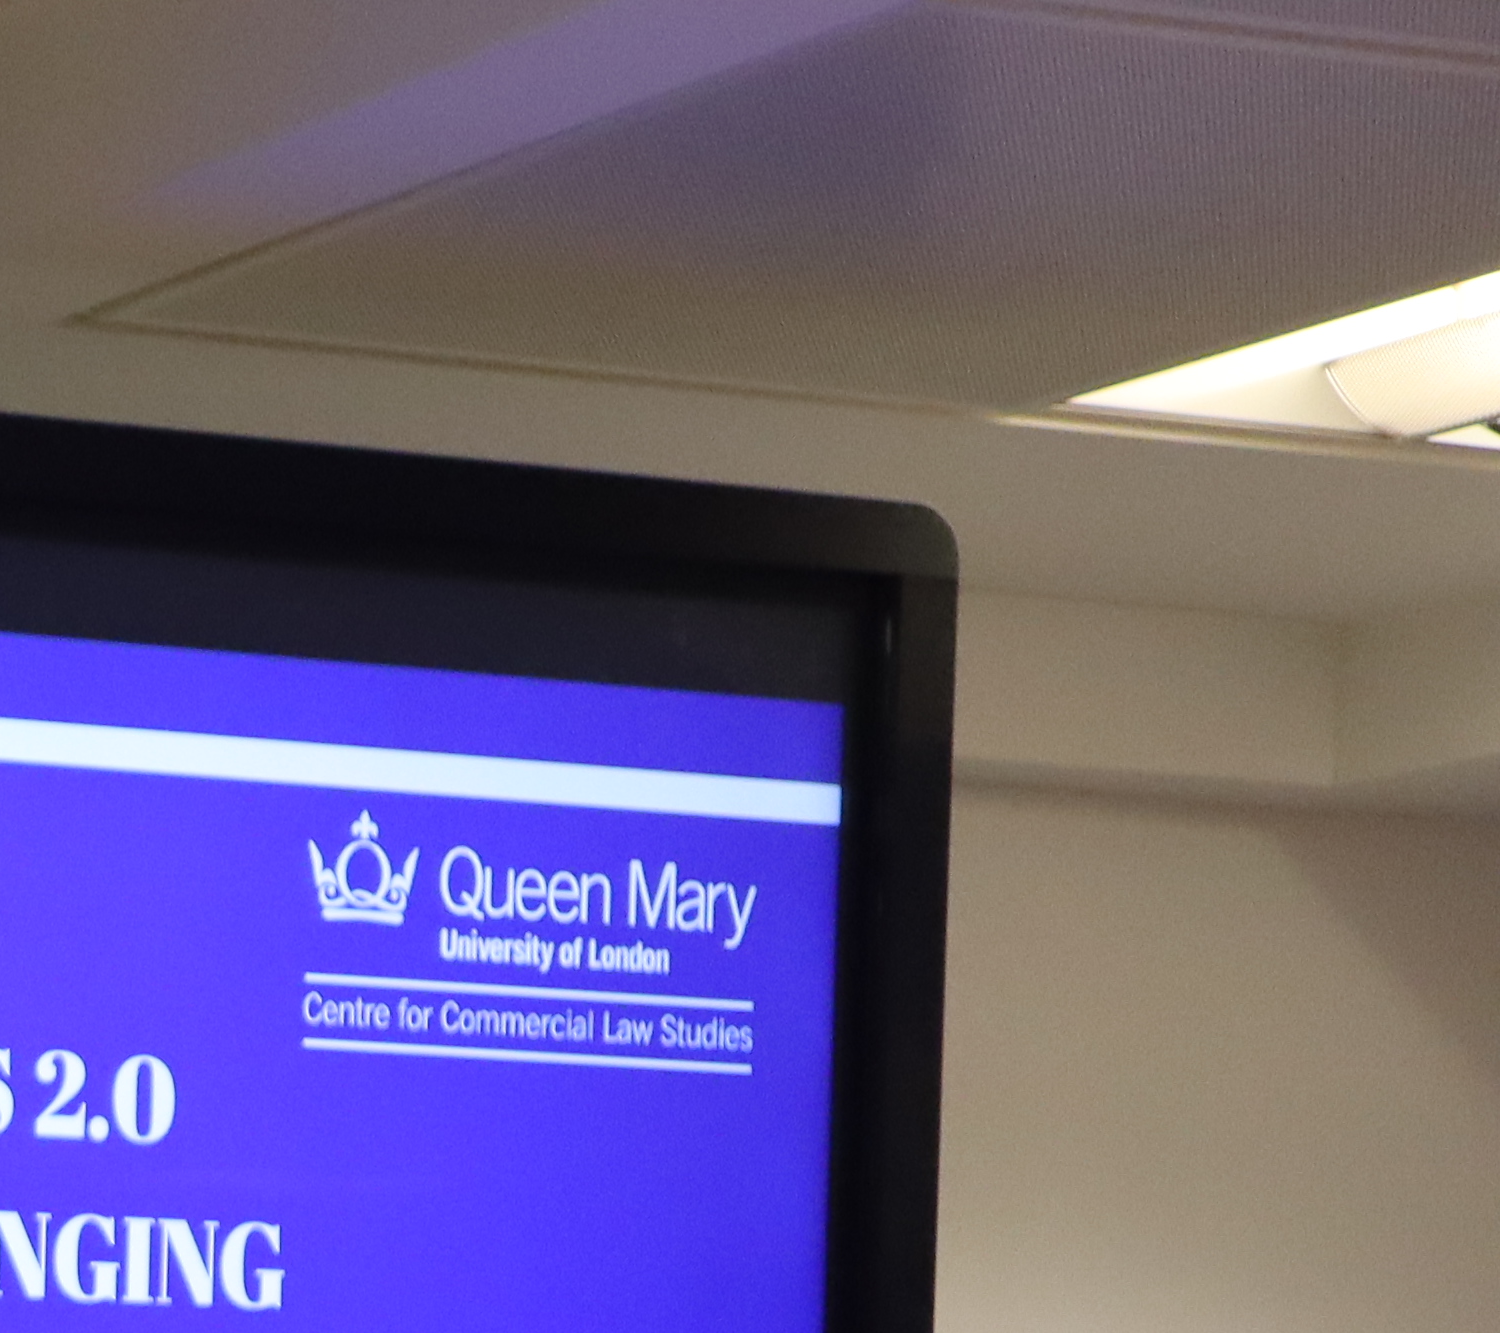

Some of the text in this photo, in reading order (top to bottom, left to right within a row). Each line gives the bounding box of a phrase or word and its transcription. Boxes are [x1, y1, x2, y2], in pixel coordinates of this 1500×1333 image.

[438, 844, 758, 951] Queen Mary
[438, 926, 671, 975] University of London
[301, 989, 754, 1053] Centre for Commercial Law Studies
[32, 1048, 177, 1146] 2.0
